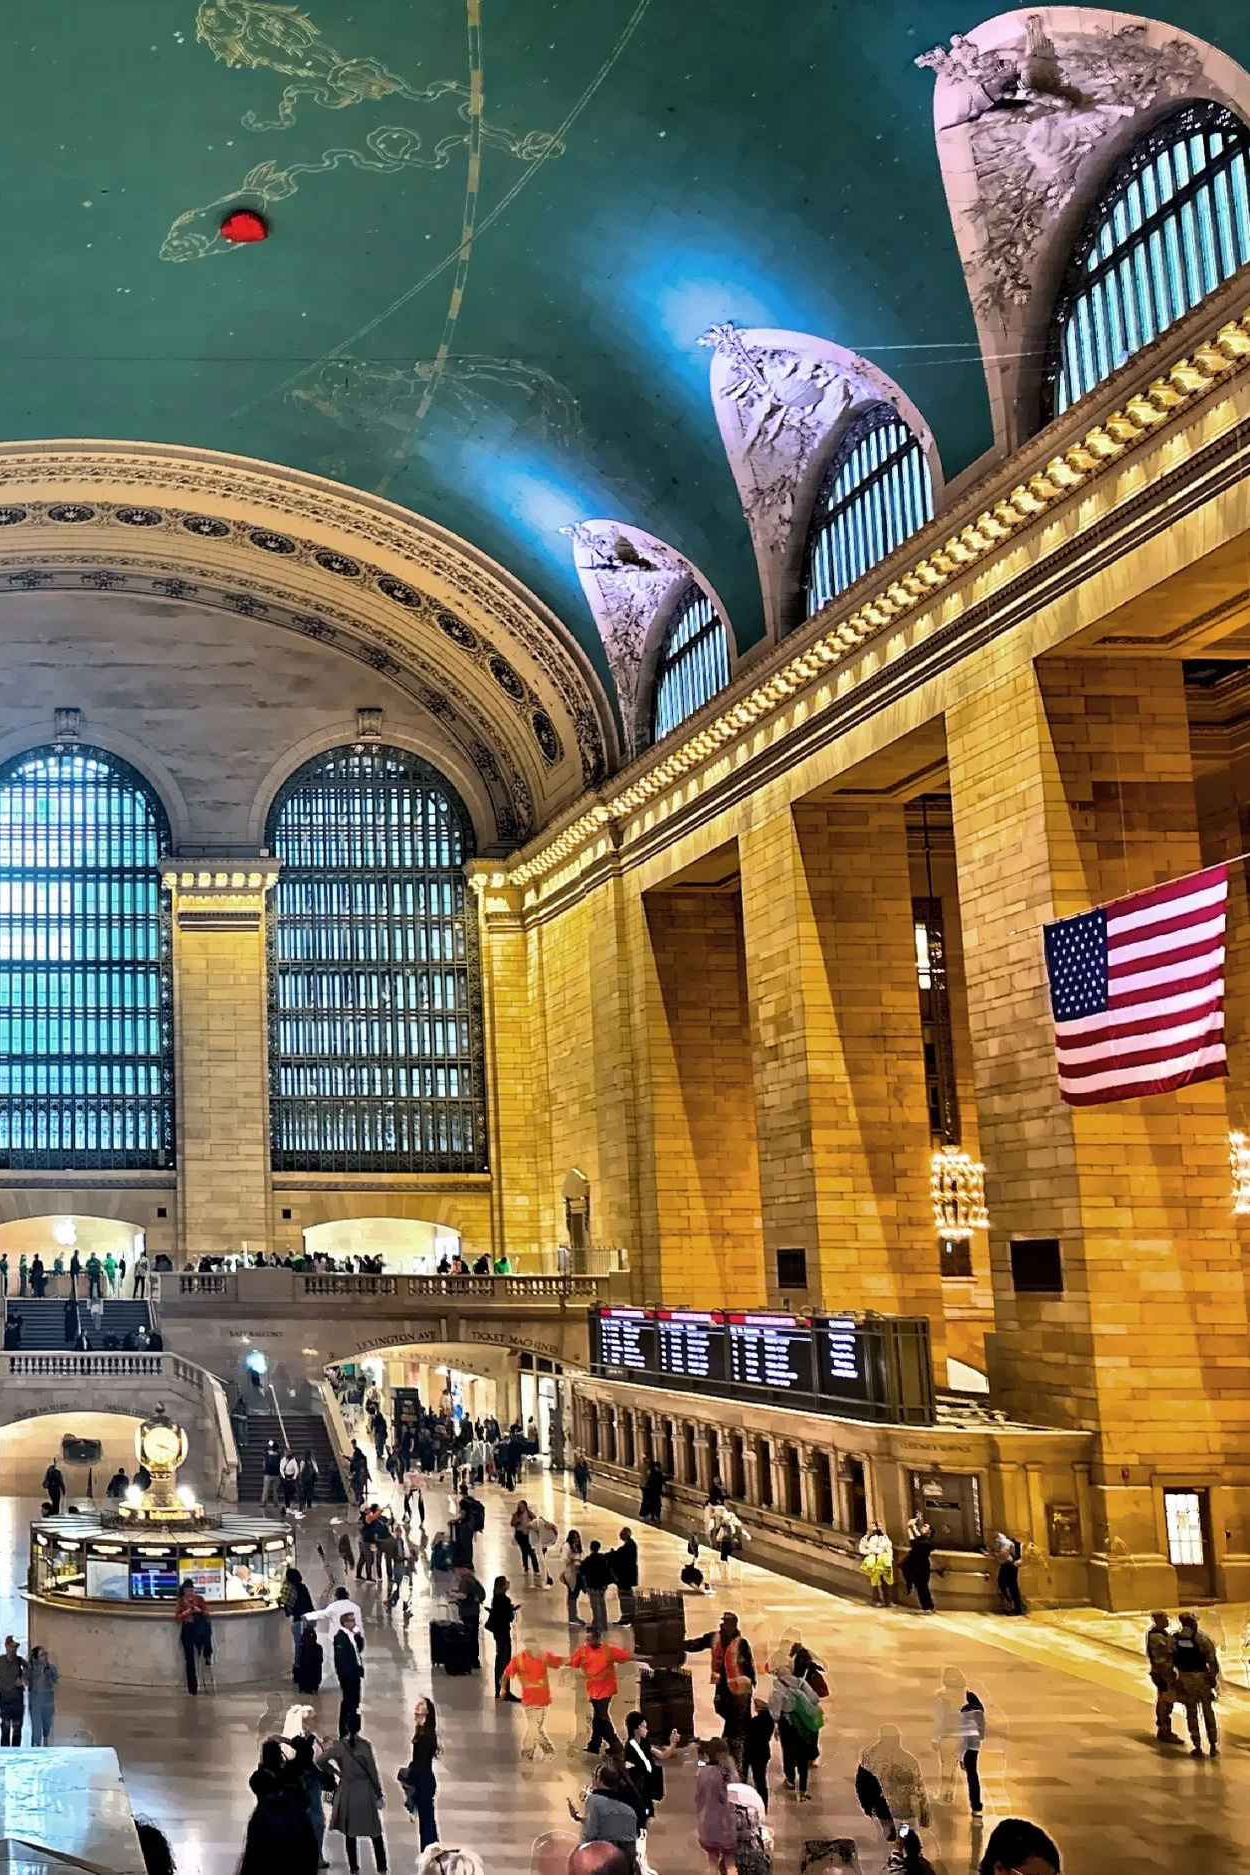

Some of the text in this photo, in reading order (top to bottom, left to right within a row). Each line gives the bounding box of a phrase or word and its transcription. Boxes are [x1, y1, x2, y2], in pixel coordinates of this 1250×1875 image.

[356, 1330, 437, 1350] LEXINGTON AVE
[471, 1331, 558, 1353] TICKET MACHINES
